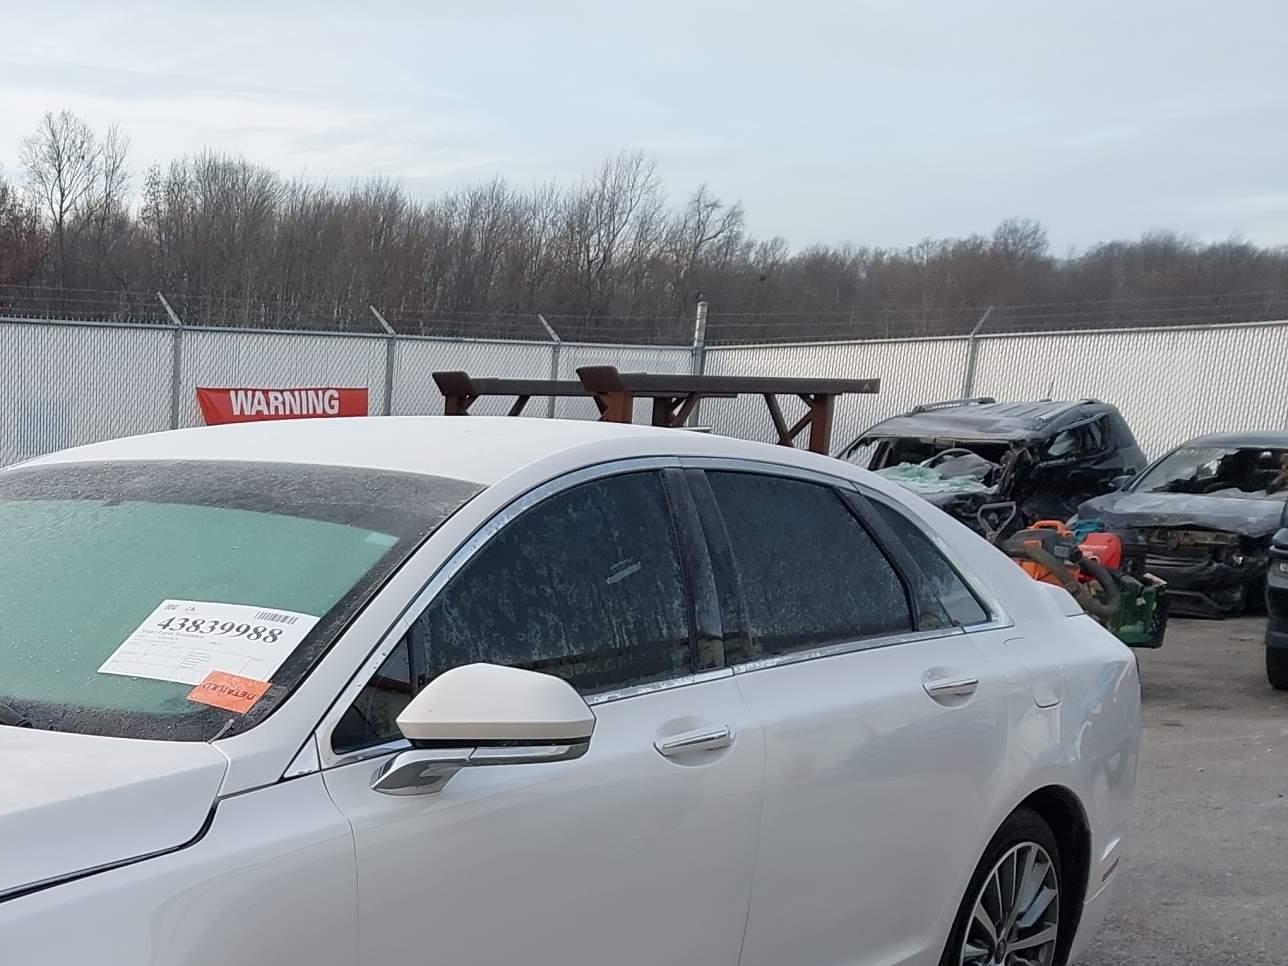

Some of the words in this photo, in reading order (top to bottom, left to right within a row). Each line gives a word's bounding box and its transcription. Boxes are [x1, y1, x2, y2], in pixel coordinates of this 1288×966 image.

[230, 389, 339, 416] WARNING
[157, 616, 284, 644] 43839988
[201, 682, 257, 701] DETAILED
